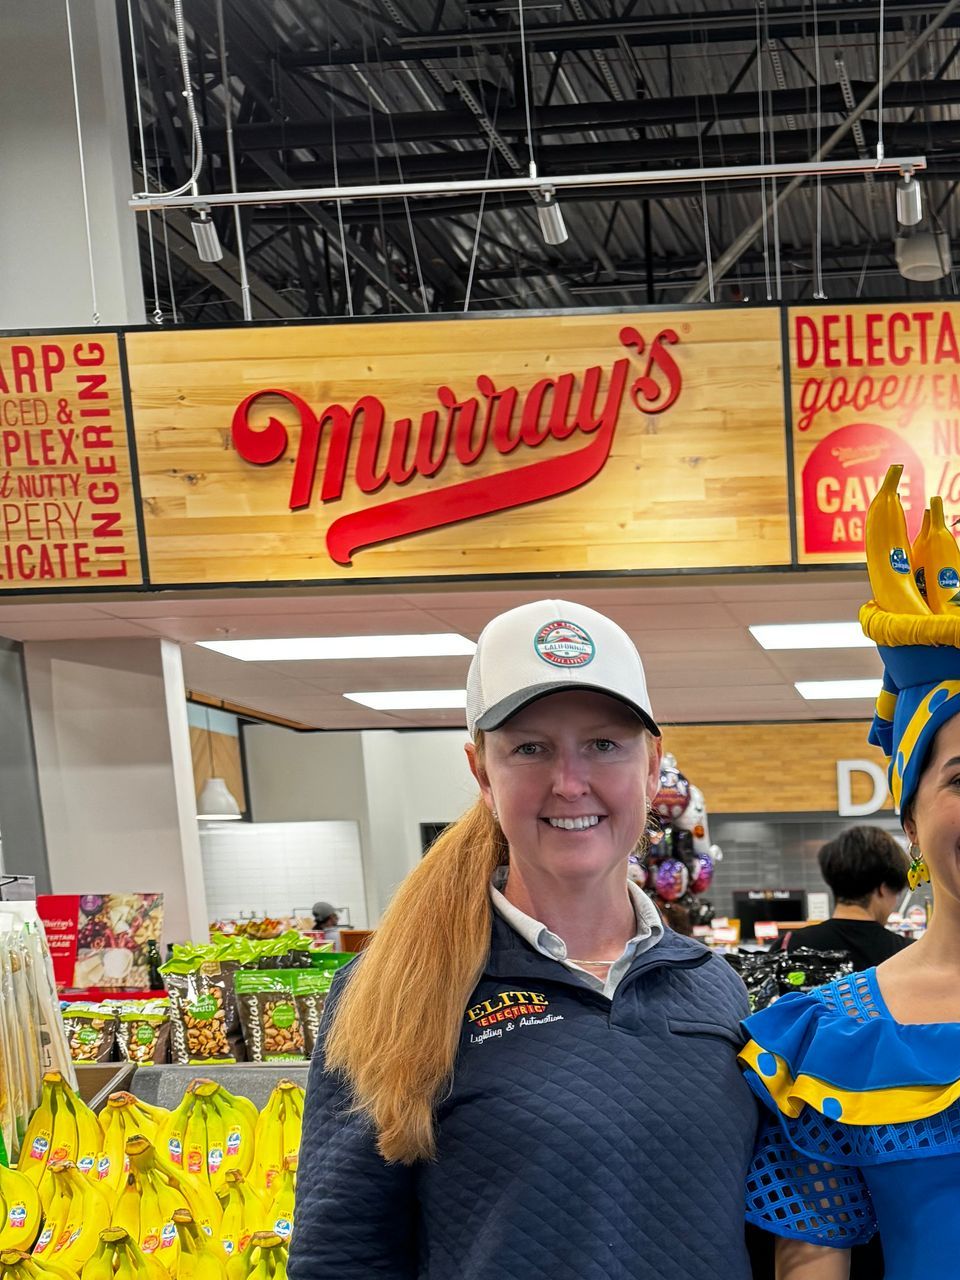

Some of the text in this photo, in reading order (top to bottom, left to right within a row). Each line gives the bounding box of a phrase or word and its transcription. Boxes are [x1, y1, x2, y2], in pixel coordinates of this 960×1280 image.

[0, 398, 74, 427] CED &
[798, 372, 927, 431] gooey
[0, 427, 79, 467] PLEX
[73, 342, 128, 578] LINGERING
[232, 326, 682, 566] Murray's
[17, 473, 81, 499] NUTTY
[832, 517, 863, 542] AG
[0, 542, 92, 581] ICATE
[467, 991, 549, 1022] ELITE
[481, 1005, 543, 1027] ELECTRIC
[506, 1022, 514, 1031] &
